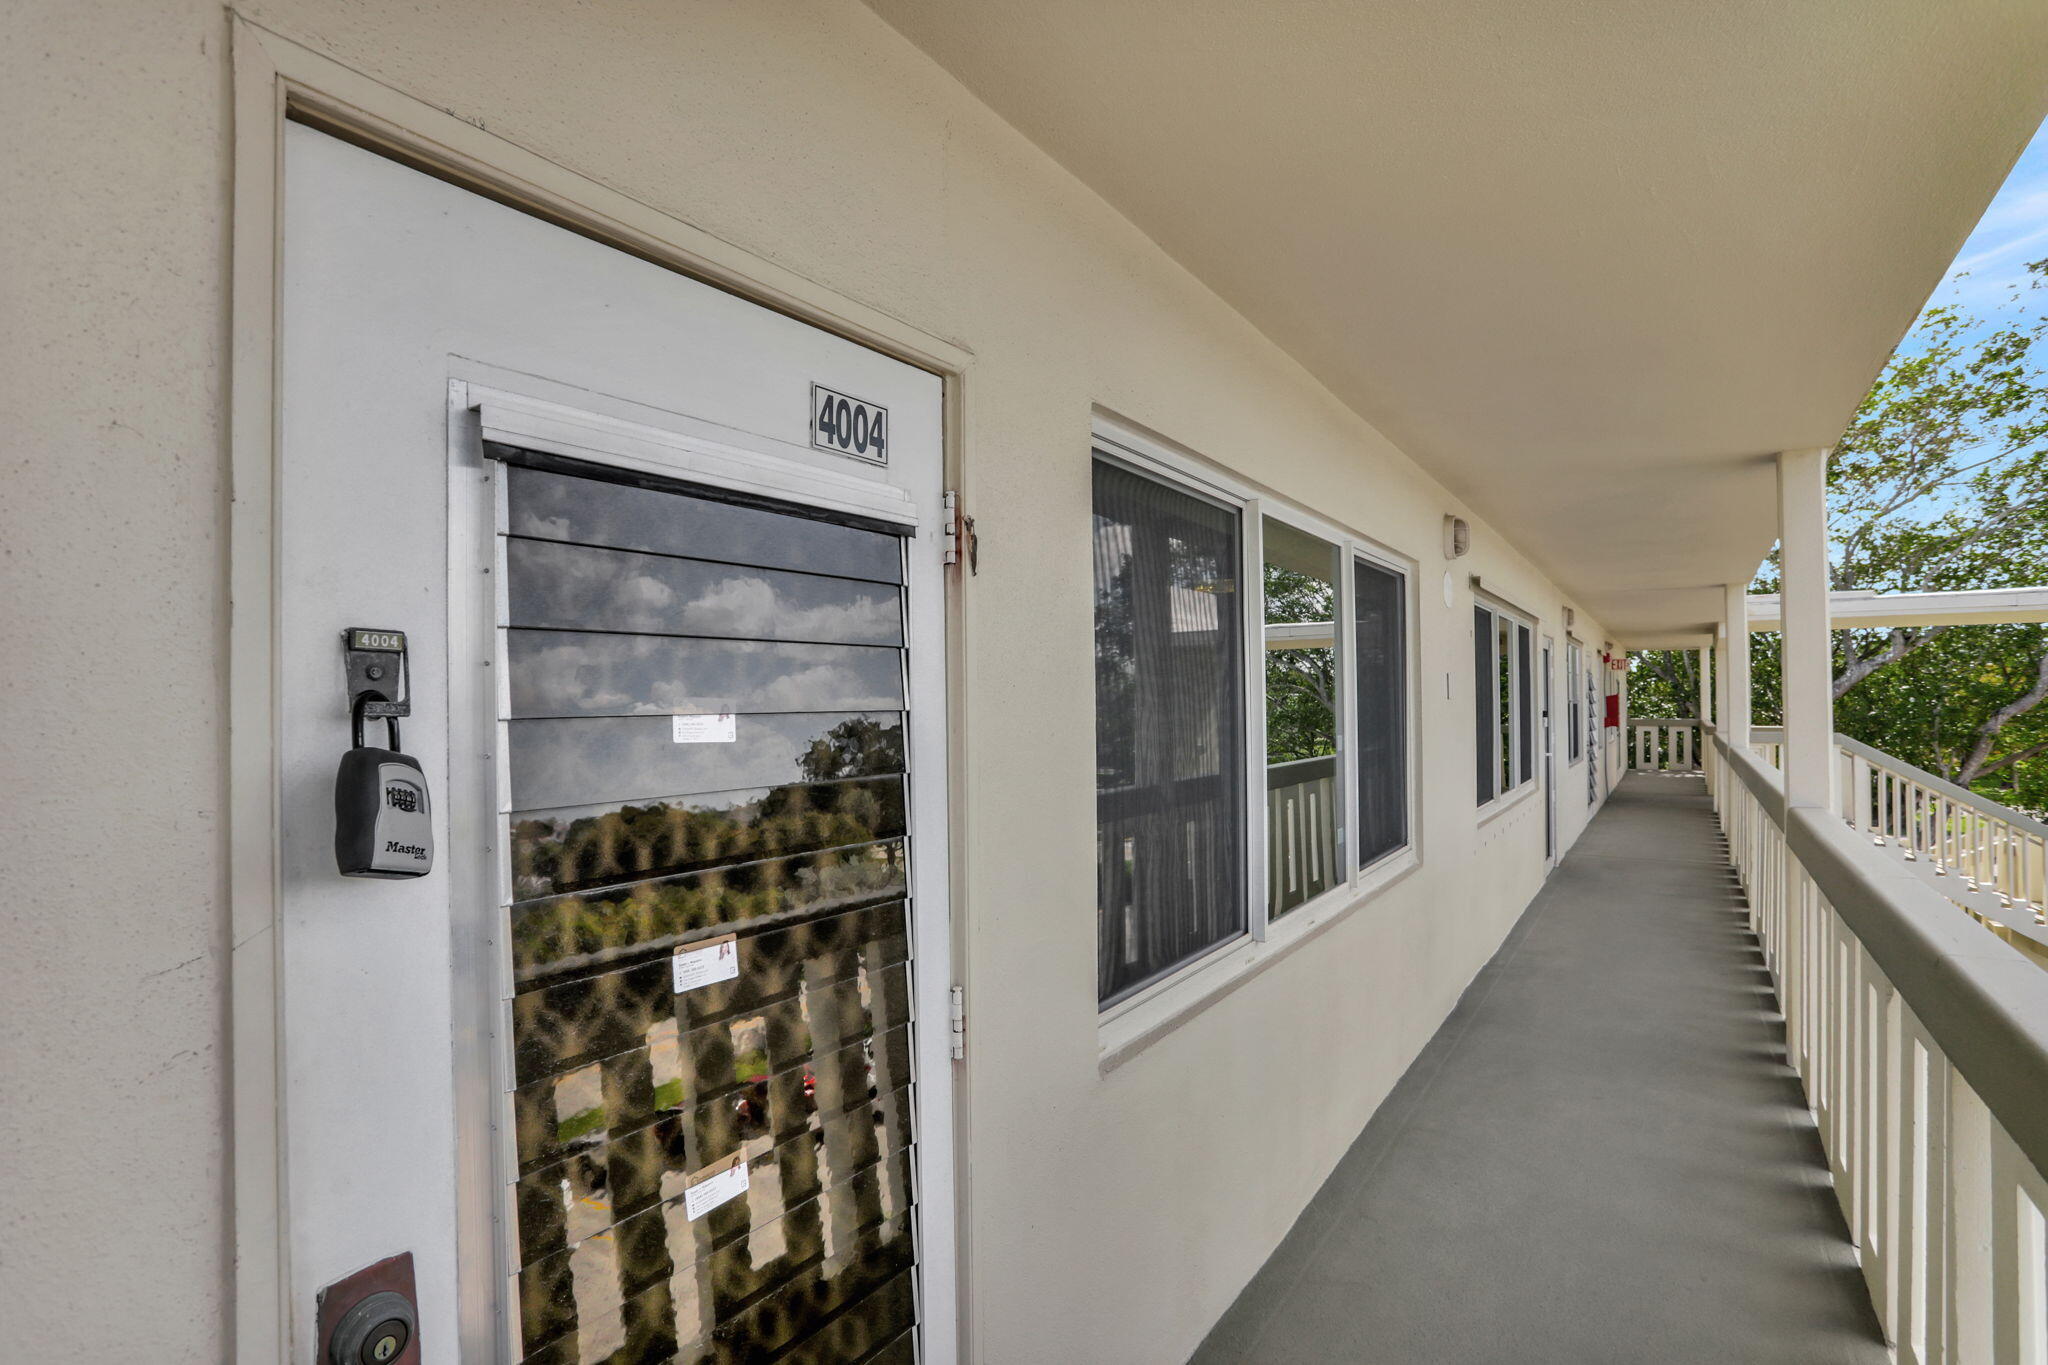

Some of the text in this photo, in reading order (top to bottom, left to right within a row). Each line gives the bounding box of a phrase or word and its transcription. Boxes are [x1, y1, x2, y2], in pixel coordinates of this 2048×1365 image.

[819, 394, 884, 459] 4004
[361, 634, 398, 647] 4004
[1612, 659, 1627, 670] EXIT
[385, 841, 426, 855] Master
